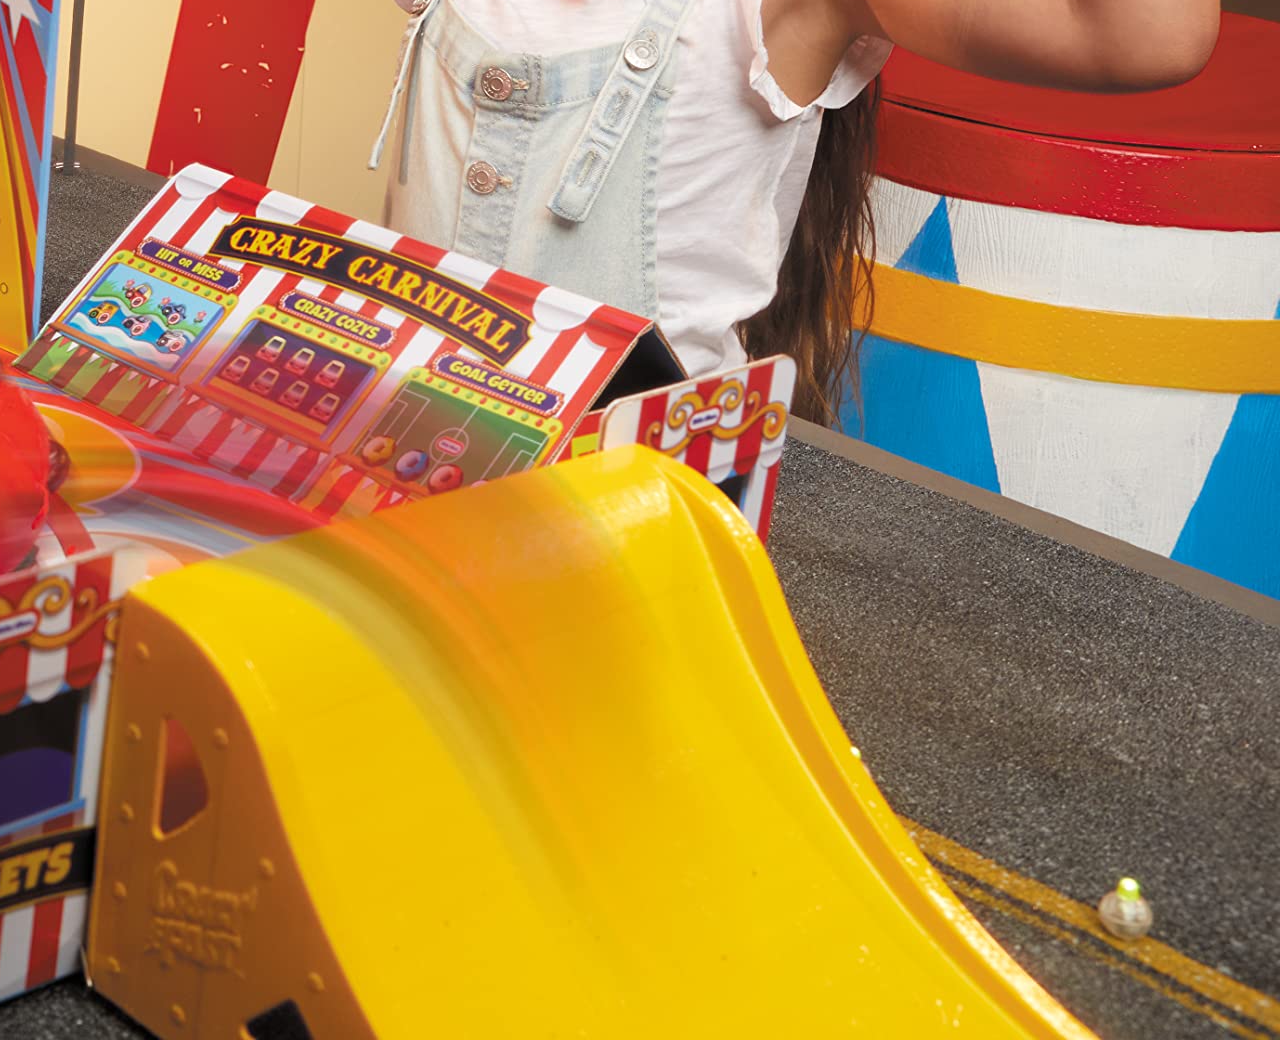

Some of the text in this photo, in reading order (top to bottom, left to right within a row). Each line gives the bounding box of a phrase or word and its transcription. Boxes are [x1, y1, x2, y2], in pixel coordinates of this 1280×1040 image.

[155, 247, 180, 263] HIT
[191, 262, 224, 281] MISS
[229, 226, 517, 354] CRAZY CARNIVAL
[293, 298, 381, 339] CRAZY COZYS
[448, 360, 489, 384] GOAL
